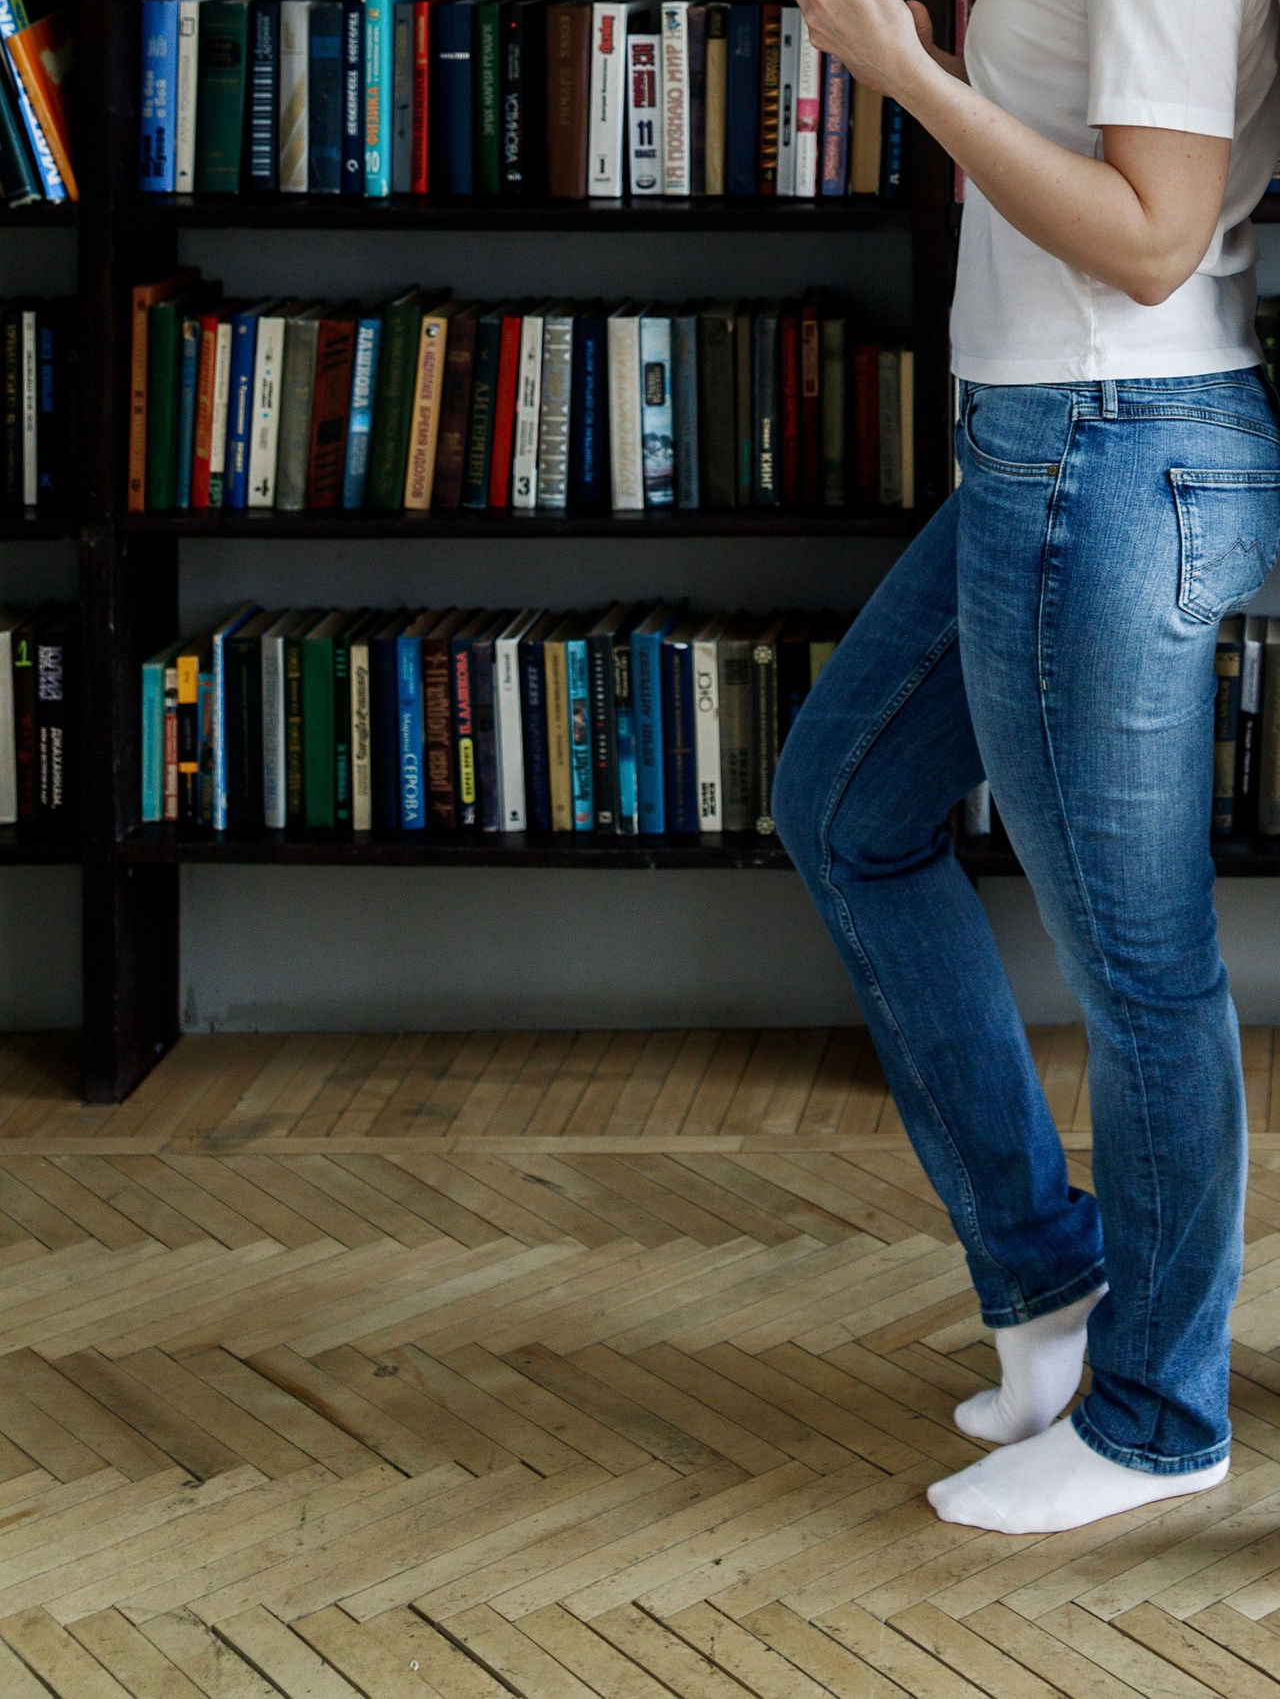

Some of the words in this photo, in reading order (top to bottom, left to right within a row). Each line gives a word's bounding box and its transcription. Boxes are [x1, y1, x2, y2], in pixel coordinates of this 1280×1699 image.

[665, 44, 683, 83] МИР
[366, 85, 380, 147] ФИЗИКА
[505, 92, 519, 164] УСТИНОВА
[665, 88, 684, 163] ПОЗНАЮ
[666, 166, 684, 181] Я
[352, 326, 375, 408] ДАШКОВА
[761, 452, 773, 491] КИНГ
[456, 651, 471, 719] ДАШКОВА
[404, 752, 419, 822] СЕРОВА
